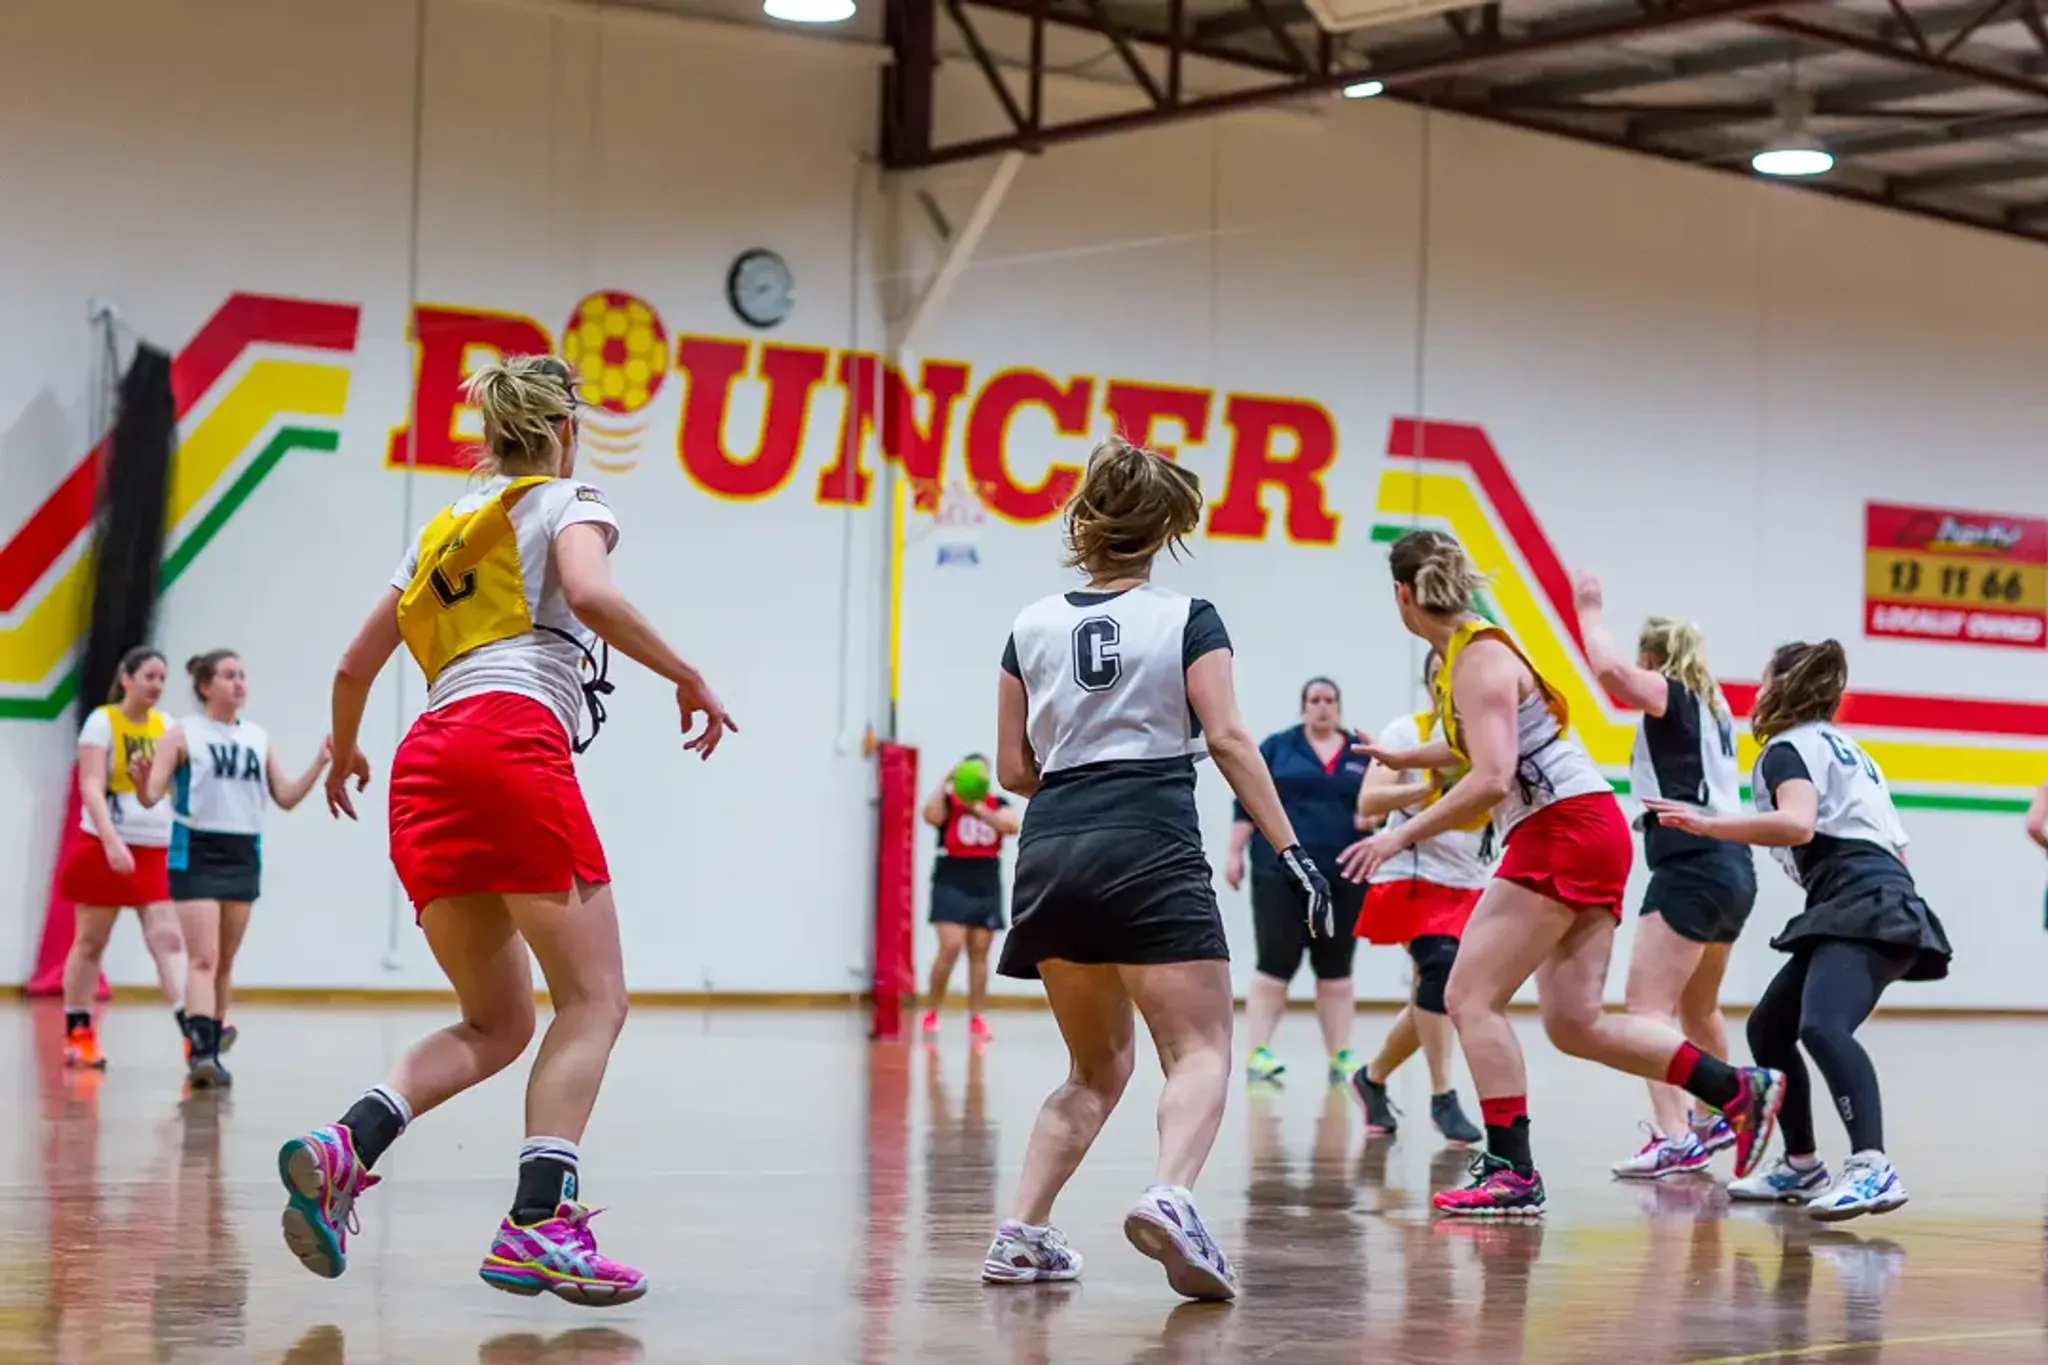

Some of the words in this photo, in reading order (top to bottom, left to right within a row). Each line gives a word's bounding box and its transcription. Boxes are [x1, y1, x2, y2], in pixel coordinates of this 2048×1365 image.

[427, 536, 477, 609] C
[1981, 570, 2022, 603] 66
[1071, 615, 1121, 692] C
[208, 743, 262, 782] WA
